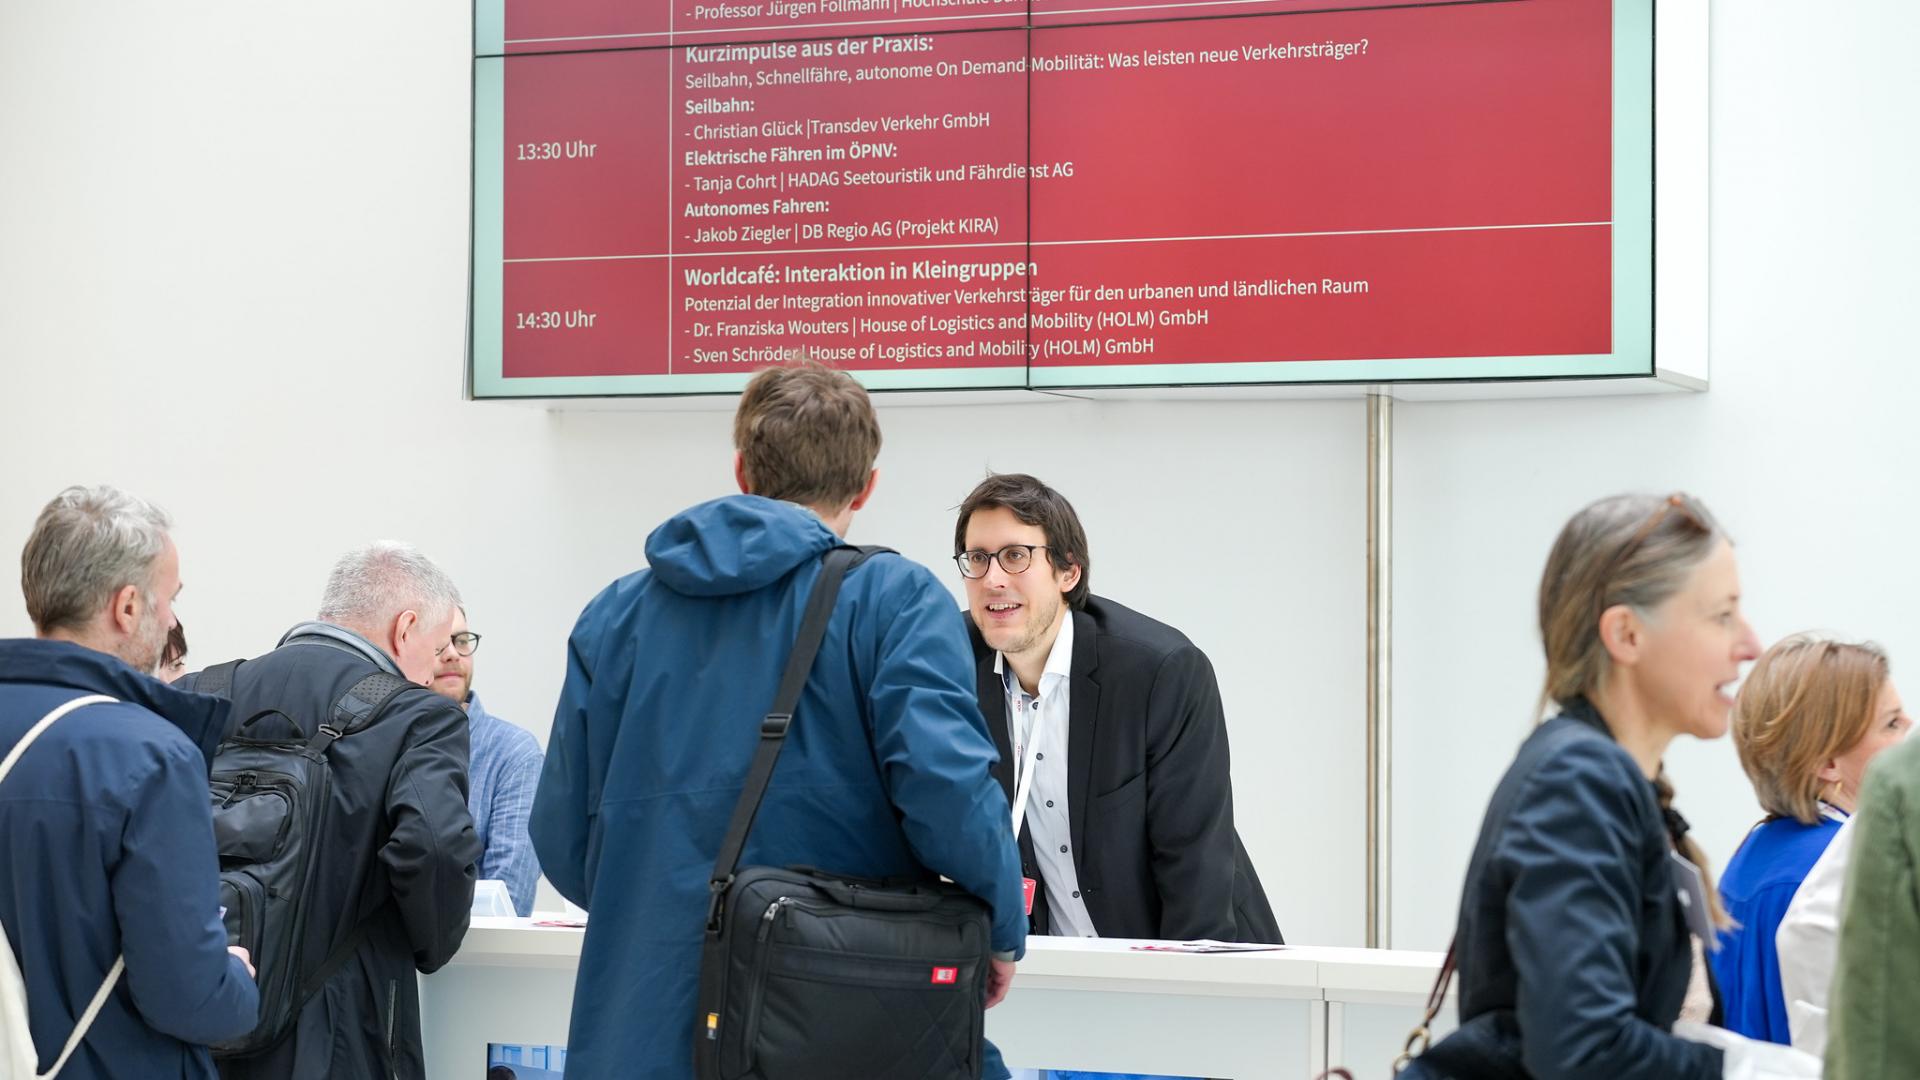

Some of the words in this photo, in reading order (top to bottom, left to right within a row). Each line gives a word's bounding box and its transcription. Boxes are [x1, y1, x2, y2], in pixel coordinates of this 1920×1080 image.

[695, 3, 763, 19] Professor
[766, 0, 816, 20] Jürgen
[821, 0, 889, 13] Follmann
[686, 42, 797, 64] Kurzimpulse
[801, 43, 833, 57] aus
[837, 39, 868, 56] der
[873, 35, 933, 53] Praxis:
[685, 72, 752, 89] Seilbahn,
[756, 67, 852, 86] Schnellfähre,
[856, 63, 933, 80] autonome
[936, 60, 958, 75] On
[1108, 52, 1140, 68] Was
[1144, 50, 1195, 66] leisten
[1200, 50, 1239, 63] neue
[1242, 38, 1368, 61] Verkehrsträger?
[685, 97, 754, 115] Seilbahn:
[694, 123, 758, 140] Christian
[762, 120, 803, 137] Glück
[881, 113, 939, 131] Verkehr
[942, 112, 990, 129] GmbH
[517, 142, 561, 160] 13:30
[566, 140, 597, 158] Uhr
[685, 148, 767, 166] Elektrische
[771, 146, 822, 162] Fähren
[826, 145, 845, 160] im
[849, 141, 897, 159] ÖPNV:
[693, 176, 733, 194] Tanja
[736, 173, 777, 190] Cohrt
[788, 171, 839, 187] HADAG
[843, 166, 932, 186] Seetouristik
[936, 164, 965, 182] und
[969, 163, 1050, 180] Fährdienst
[1052, 162, 1073, 177] AG
[684, 203, 769, 217] Autonomes
[773, 198, 829, 214] Fahren:
[693, 226, 738, 243] Jakob
[741, 225, 792, 244] Ziegler
[802, 224, 823, 239] DB
[827, 222, 868, 242] Regio
[871, 221, 892, 237] AG
[896, 218, 955, 239] (Projekt
[959, 216, 999, 236] KIRA)
[684, 264, 780, 286] Worldcafé:
[785, 262, 885, 283] Interaktion
[890, 261, 907, 280] in
[912, 260, 1037, 283] Kleingruppen
[685, 295, 751, 312] Potenzial
[754, 294, 780, 310] der
[783, 292, 863, 312] Integration
[867, 290, 952, 307] innovativer
[1068, 285, 1092, 301] für
[1094, 284, 1124, 301] den
[1128, 283, 1194, 300] urbanen
[1198, 281, 1228, 298] und
[1233, 279, 1318, 297] ländlichen
[1322, 278, 1368, 294] Raum
[516, 311, 561, 329] 14:30
[565, 309, 597, 328] Uhr
[694, 322, 713, 337] Dr.
[717, 320, 784, 336] Franziska
[788, 320, 849, 335] Wouters
[861, 318, 907, 333] House
[911, 315, 927, 332] of
[930, 315, 995, 335] Logistics
[998, 313, 1025, 329] and
[1033, 312, 1093, 332] Mobility
[1097, 310, 1154, 330] (HOLM)
[1159, 309, 1208, 326] GmbH
[693, 348, 728, 363] Sven
[732, 346, 798, 363] Schröder
[810, 344, 856, 360] House
[859, 343, 875, 359] of
[878, 342, 943, 362] Logistics
[946, 341, 974, 357] and
[1044, 338, 1101, 358] (HOLM)
[1105, 337, 1154, 354] GmbH
